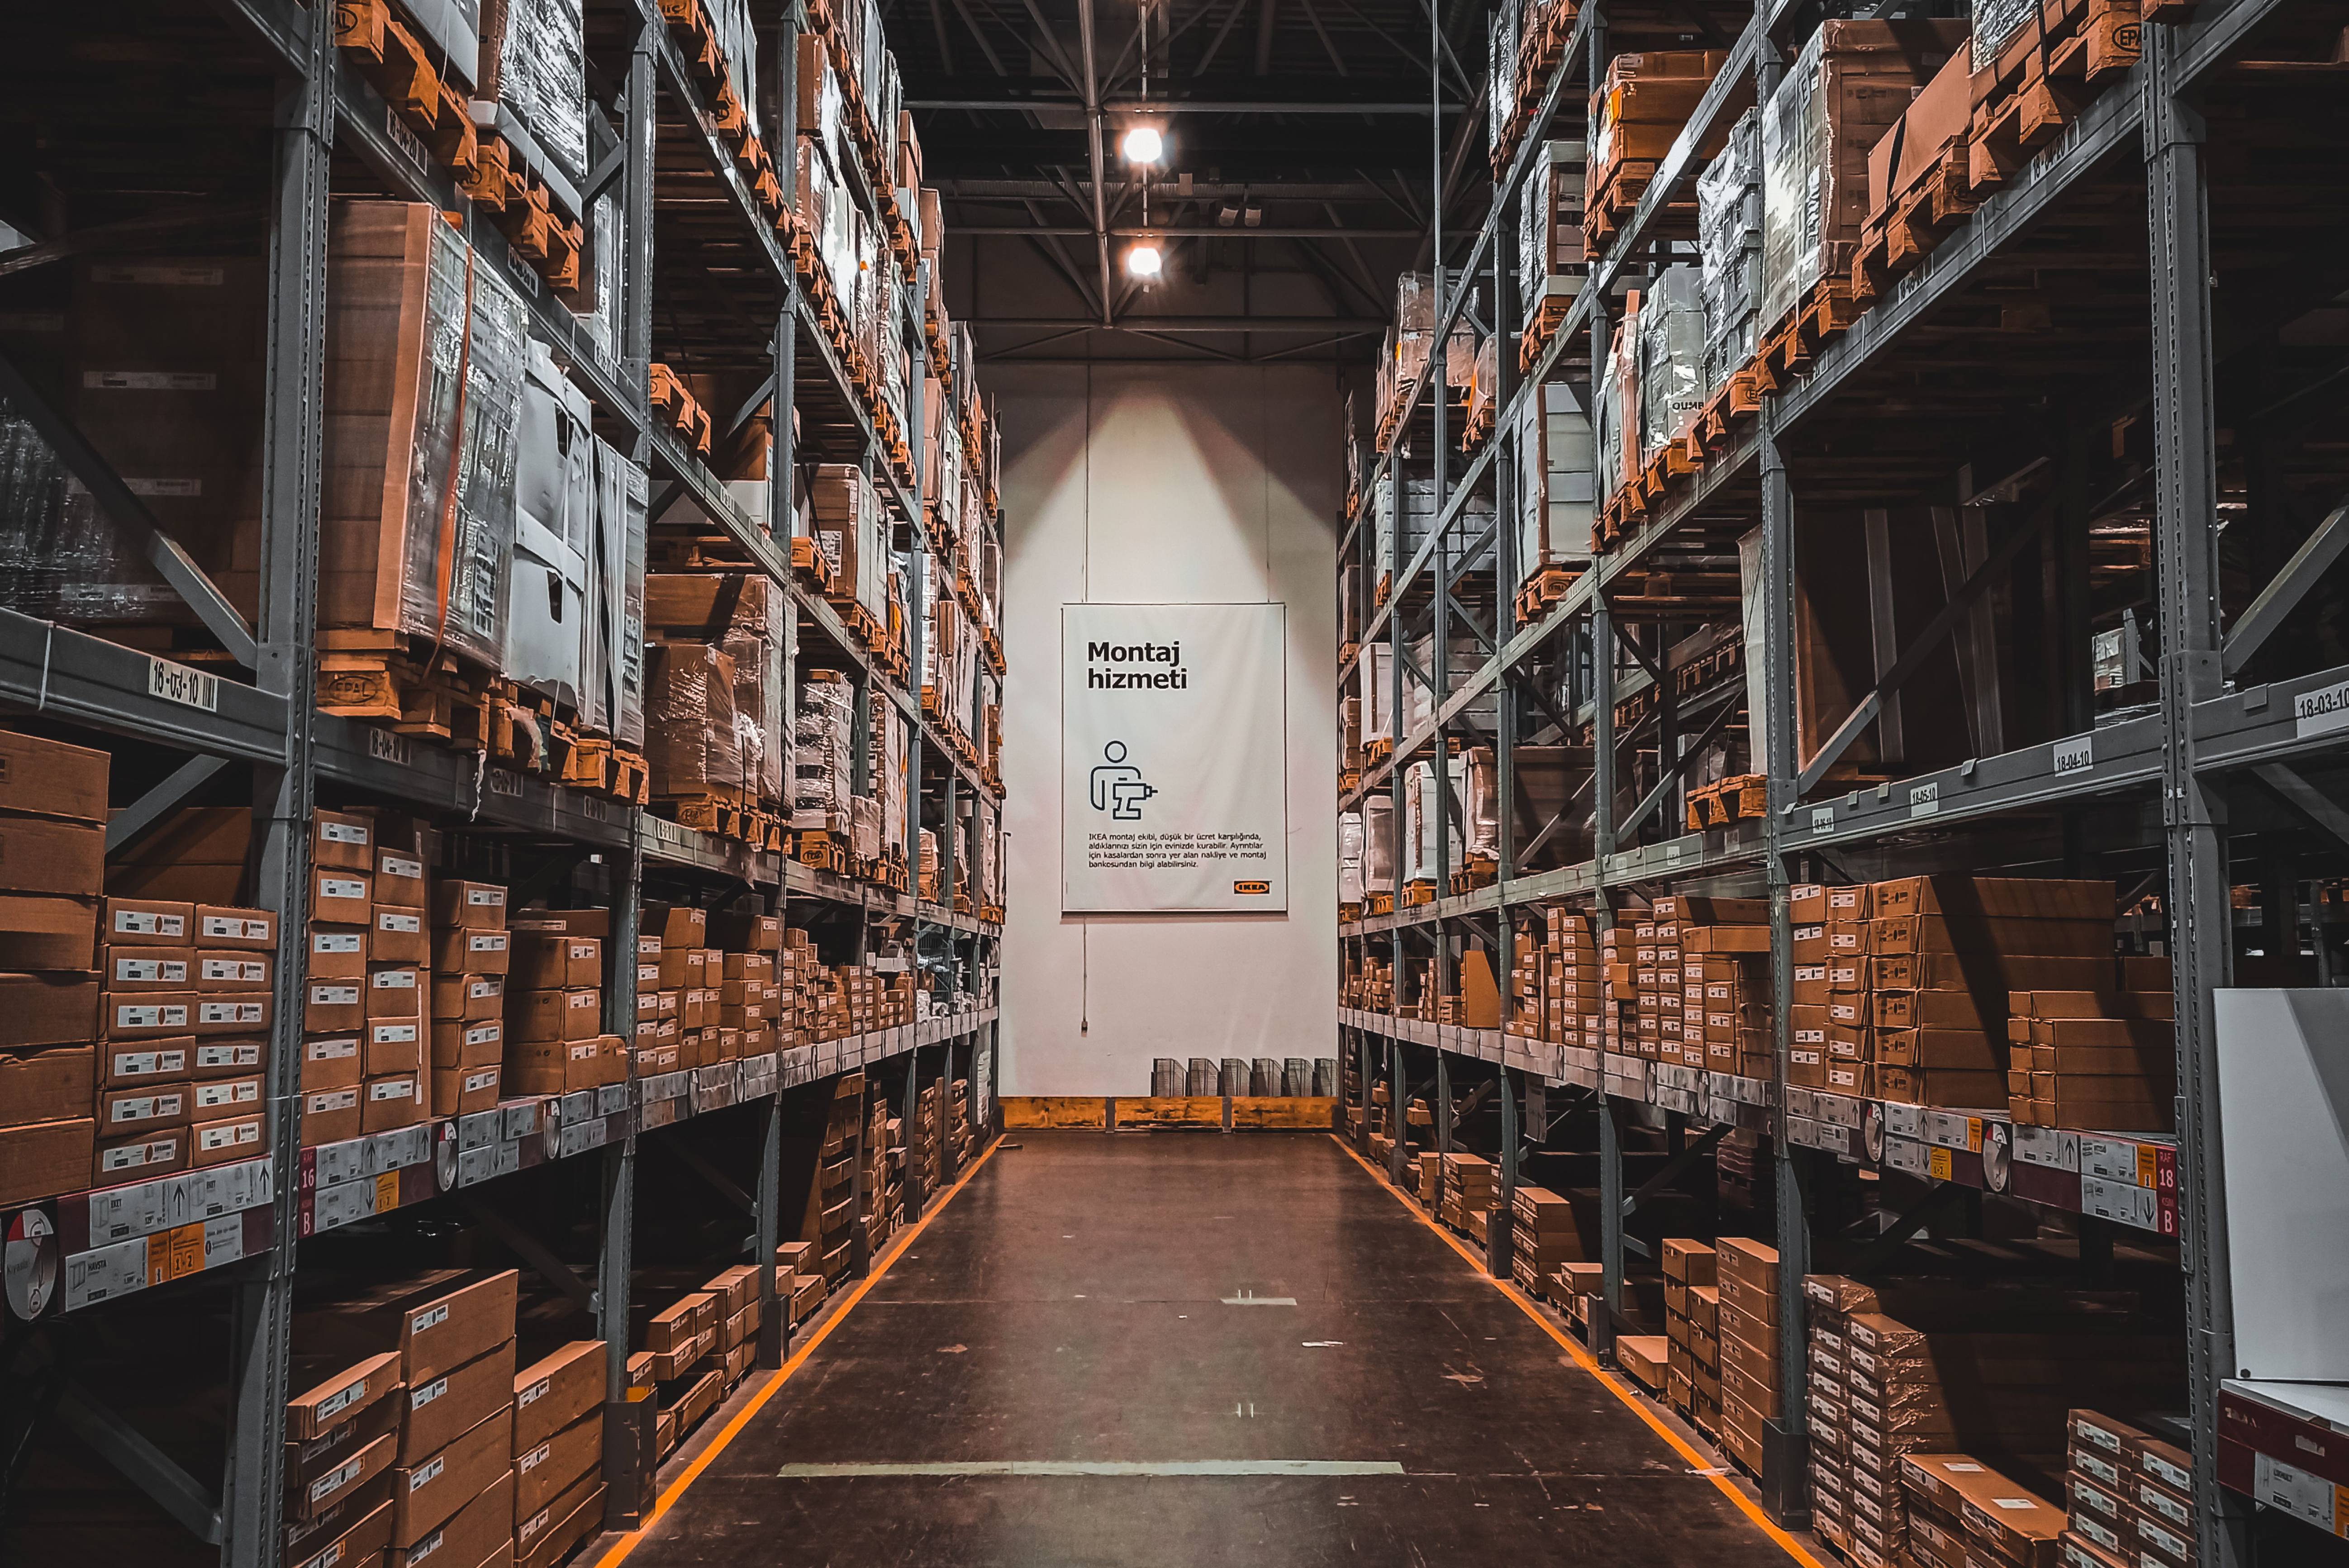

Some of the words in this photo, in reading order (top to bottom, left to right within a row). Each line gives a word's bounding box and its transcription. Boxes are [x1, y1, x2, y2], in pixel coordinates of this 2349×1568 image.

[1089, 641, 1180, 667] Montaj
[1089, 668, 1187, 689] hizmeti
[2300, 687, 2349, 719] 18-03-10
[2057, 751, 2089, 771] 18-04-10
[1913, 787, 1935, 805] 18-05-10
[1109, 833, 1135, 841] montaj
[1160, 833, 1182, 841] düşük
[1218, 833, 1261, 841] karşılığında,
[1150, 842, 1162, 851] için
[1089, 851, 1101, 860] için
[1201, 851, 1227, 860] nakliye
[1241, 851, 1266, 860] montaj
[303, 1168, 314, 1188] 16
[2160, 1168, 2173, 1188] 18
[304, 1212, 310, 1235] B
[2164, 1210, 2173, 1232] B
